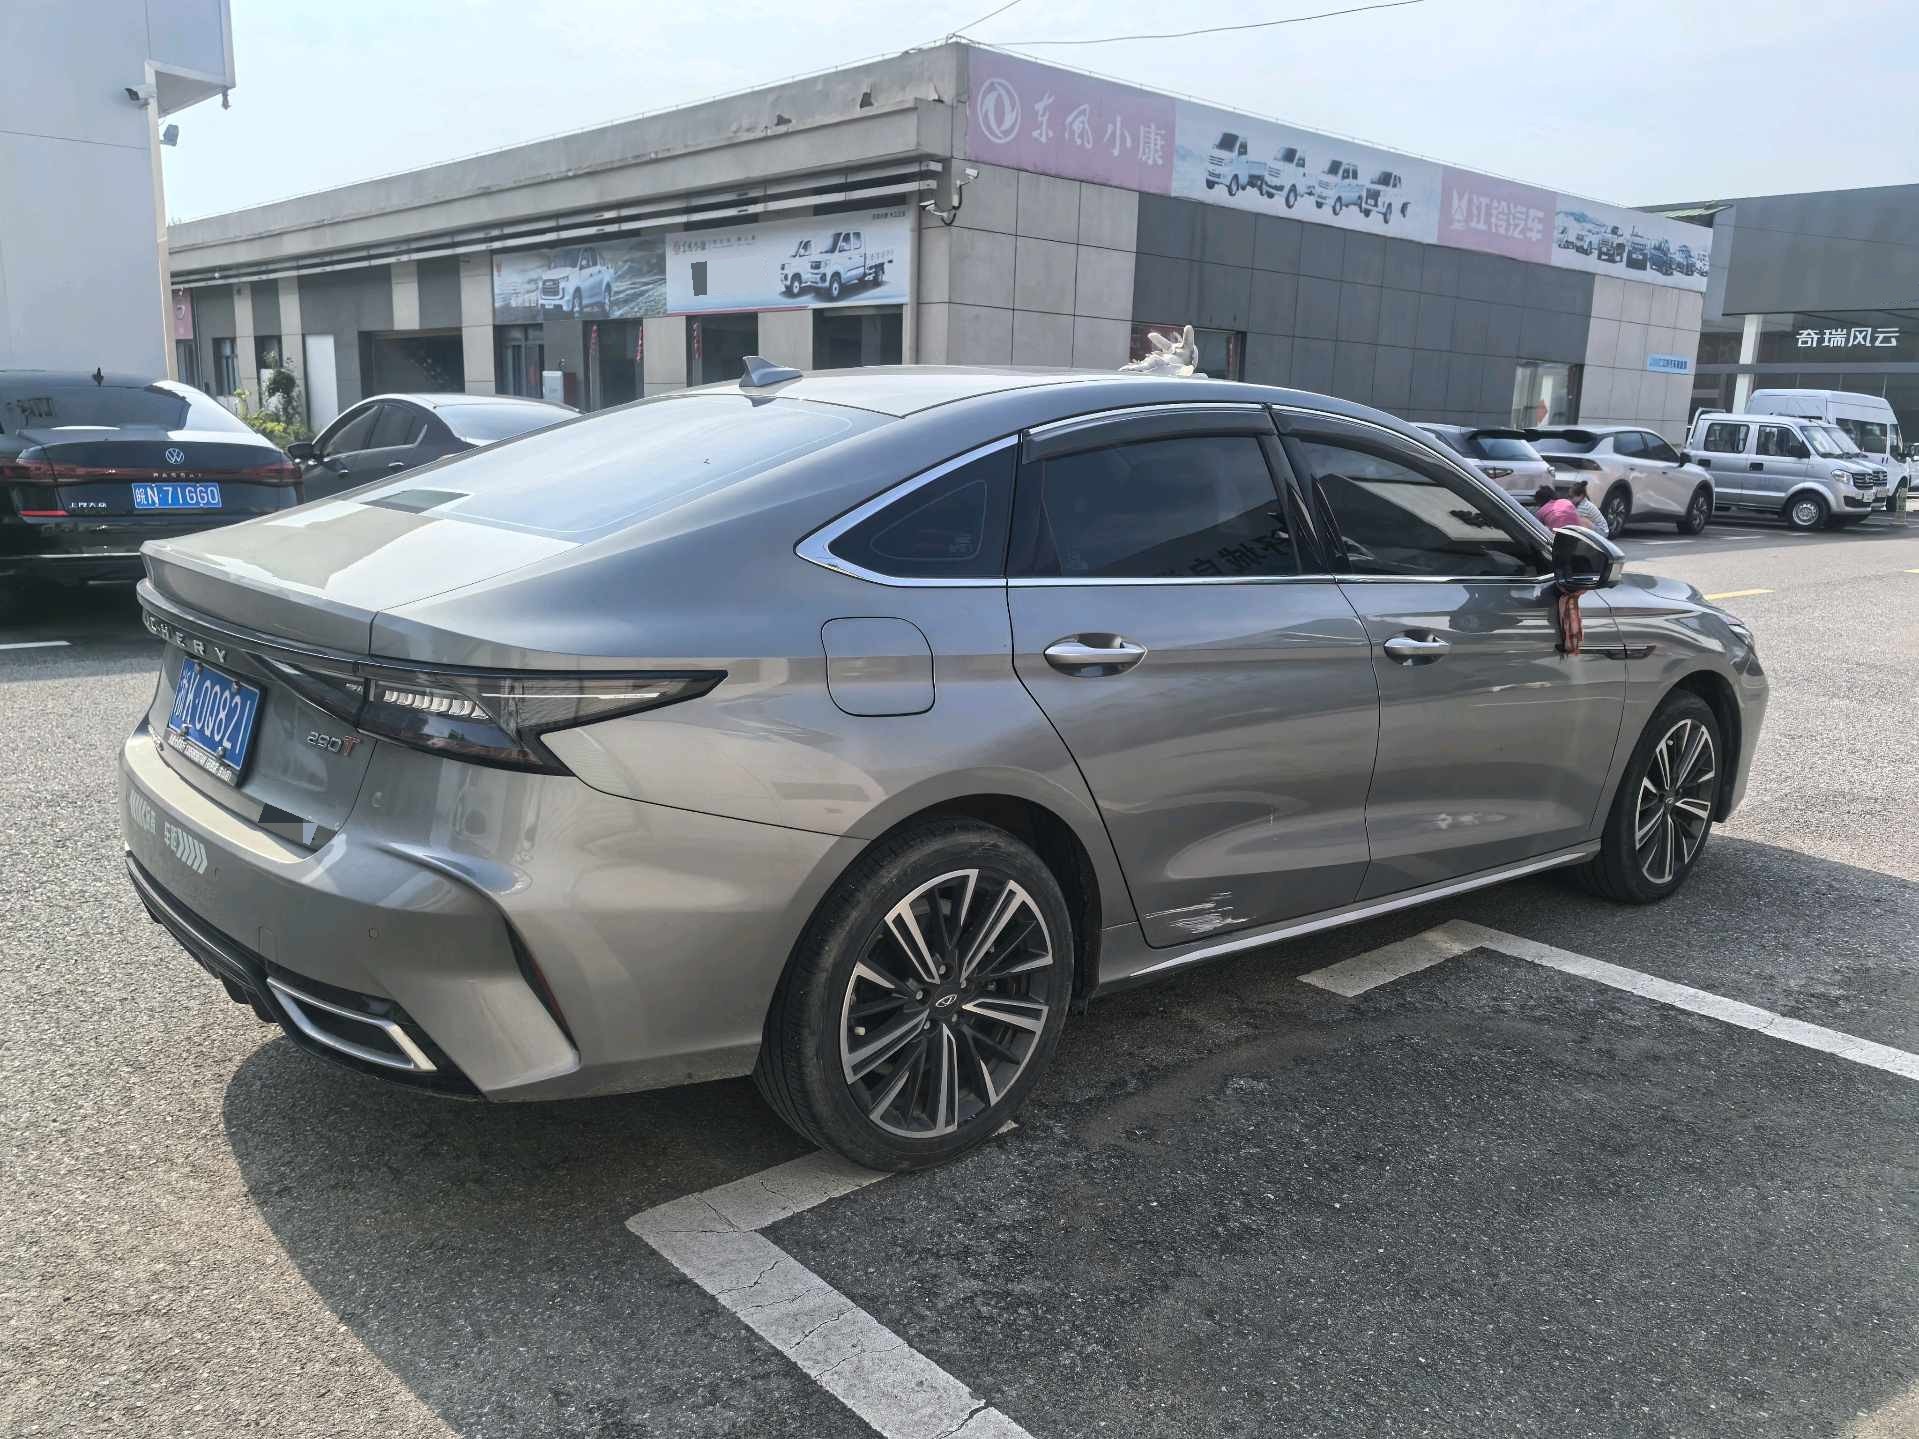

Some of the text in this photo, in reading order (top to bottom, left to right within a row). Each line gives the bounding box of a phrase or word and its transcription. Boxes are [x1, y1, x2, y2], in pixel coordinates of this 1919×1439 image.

[1470, 193, 1545, 241] 江铃汽车
[1796, 327, 1900, 348] 奇瑞风云
[307, 731, 360, 756] 290T
